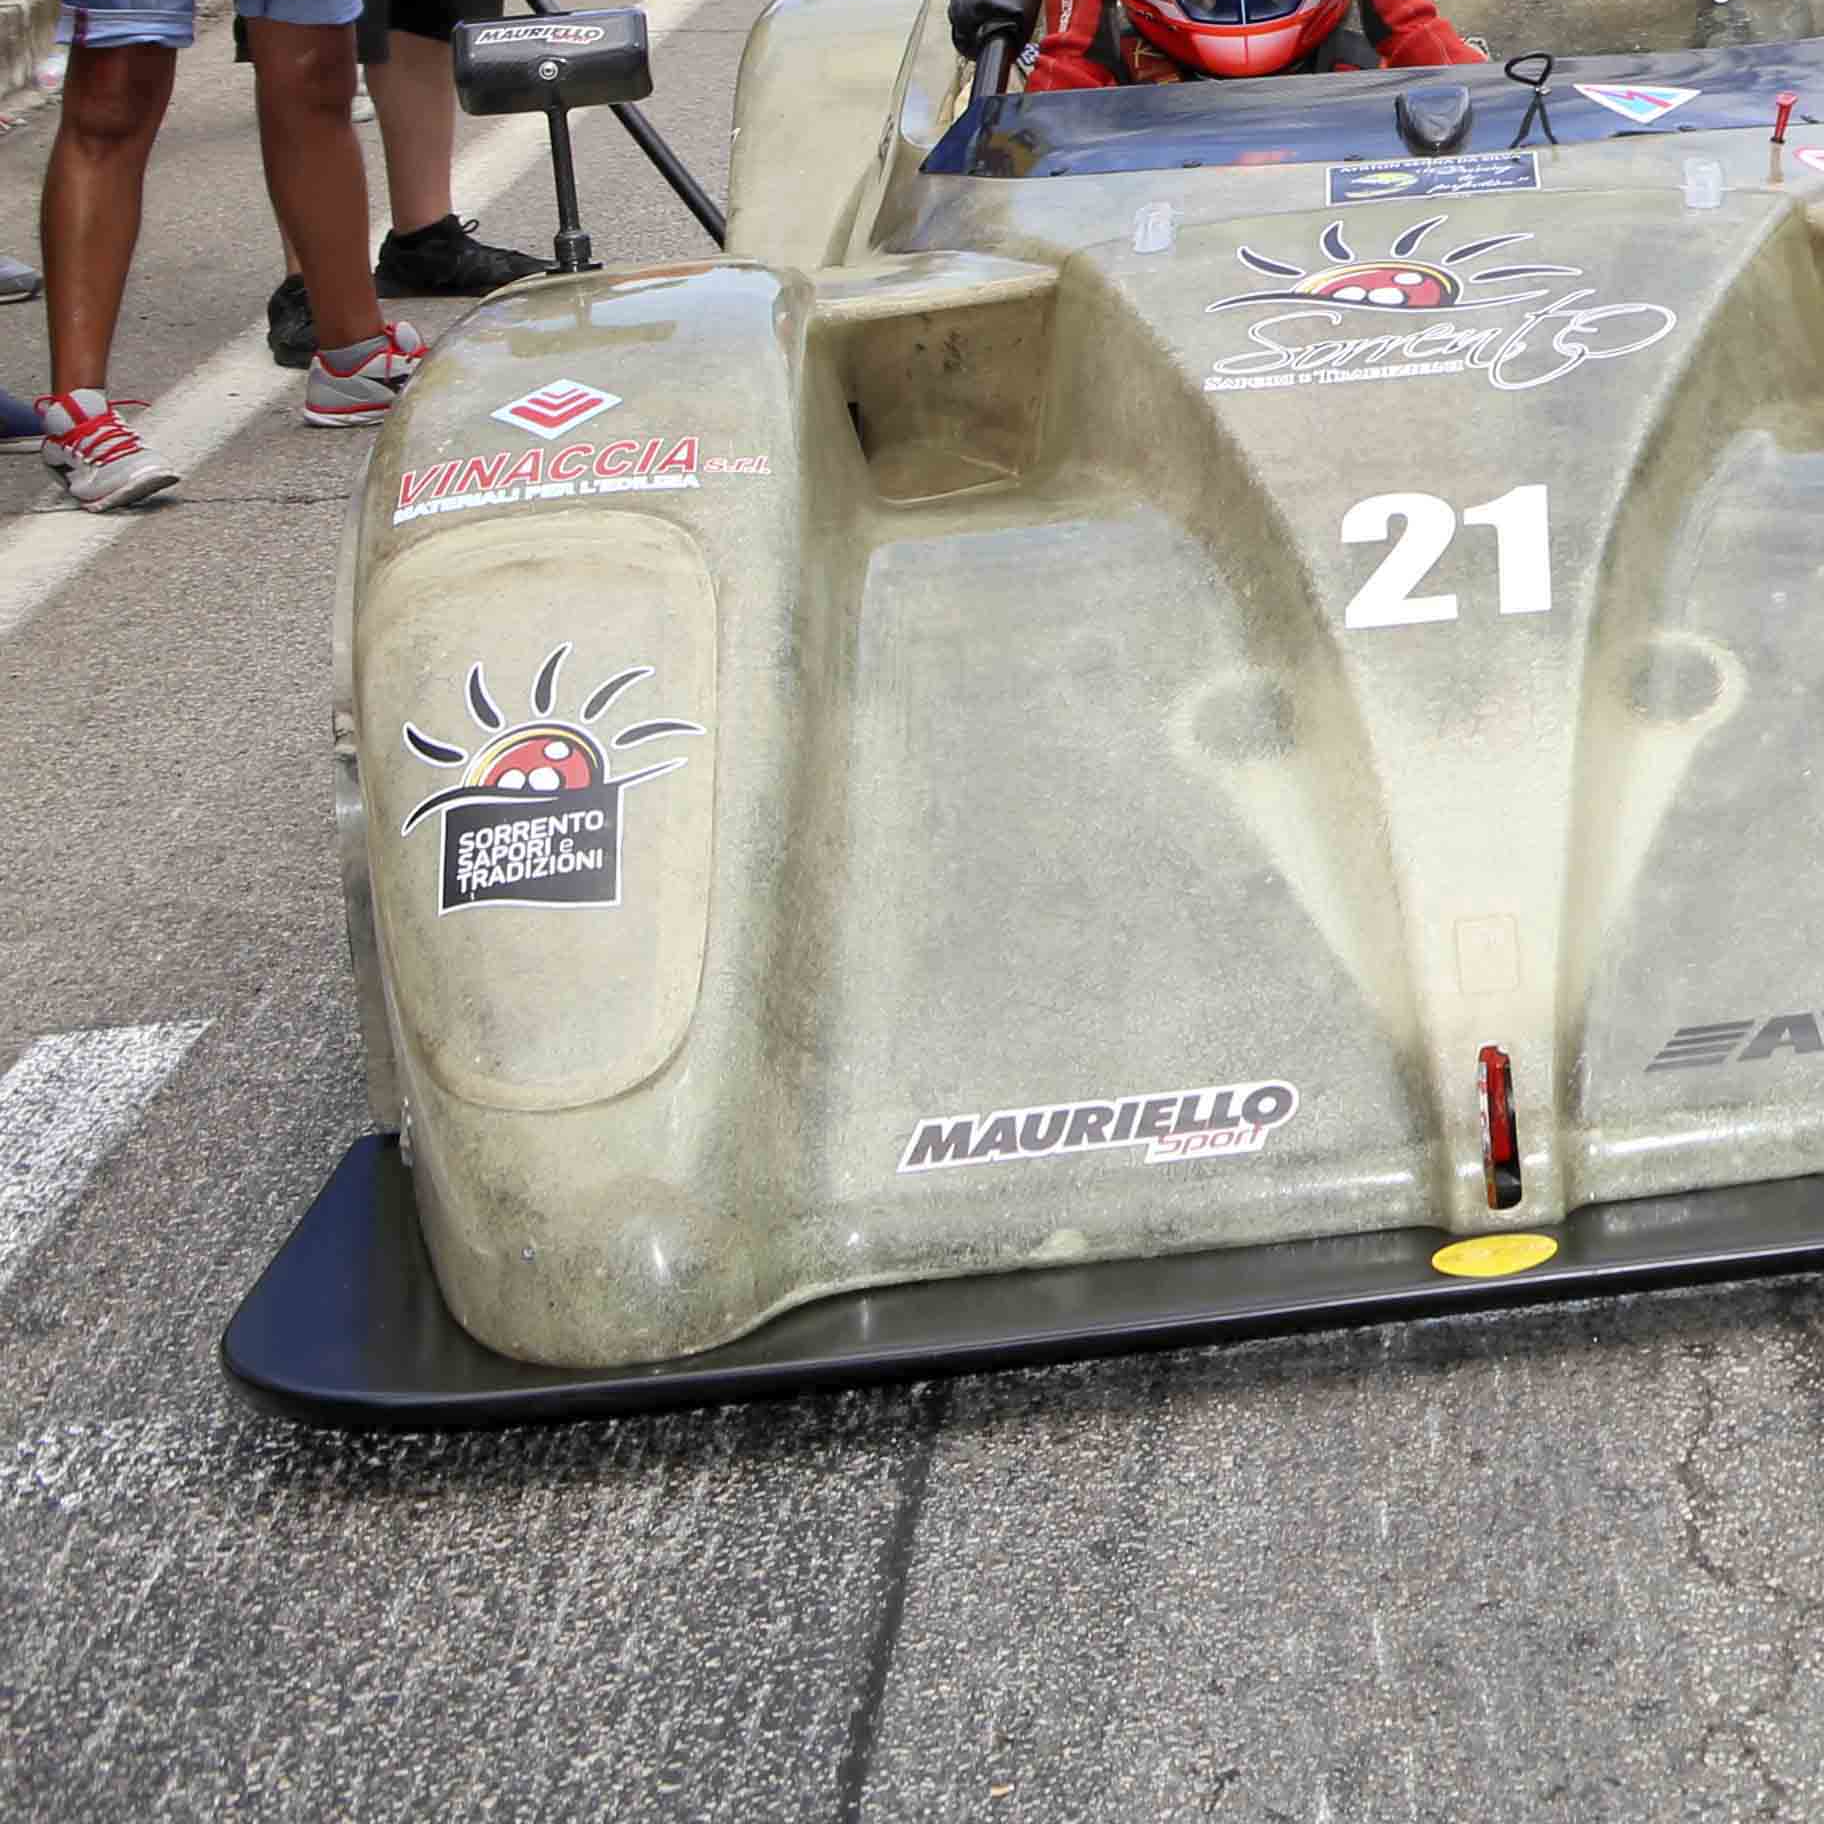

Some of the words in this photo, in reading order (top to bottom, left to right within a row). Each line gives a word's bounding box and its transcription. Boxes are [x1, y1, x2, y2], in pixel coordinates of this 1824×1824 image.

[480, 26, 600, 43] MAURIELLO
[397, 435, 701, 509] VINACCIA
[524, 481, 577, 502] PER
[1341, 484, 1552, 629] 21
[458, 810, 604, 856] SORRENTO
[456, 848, 603, 894] TRADIZIONI
[457, 837, 552, 876] SAPORI
[559, 837, 574, 854] e
[905, 1084, 1294, 1167] MAURIELLO
[1157, 1120, 1265, 1155] Sport
